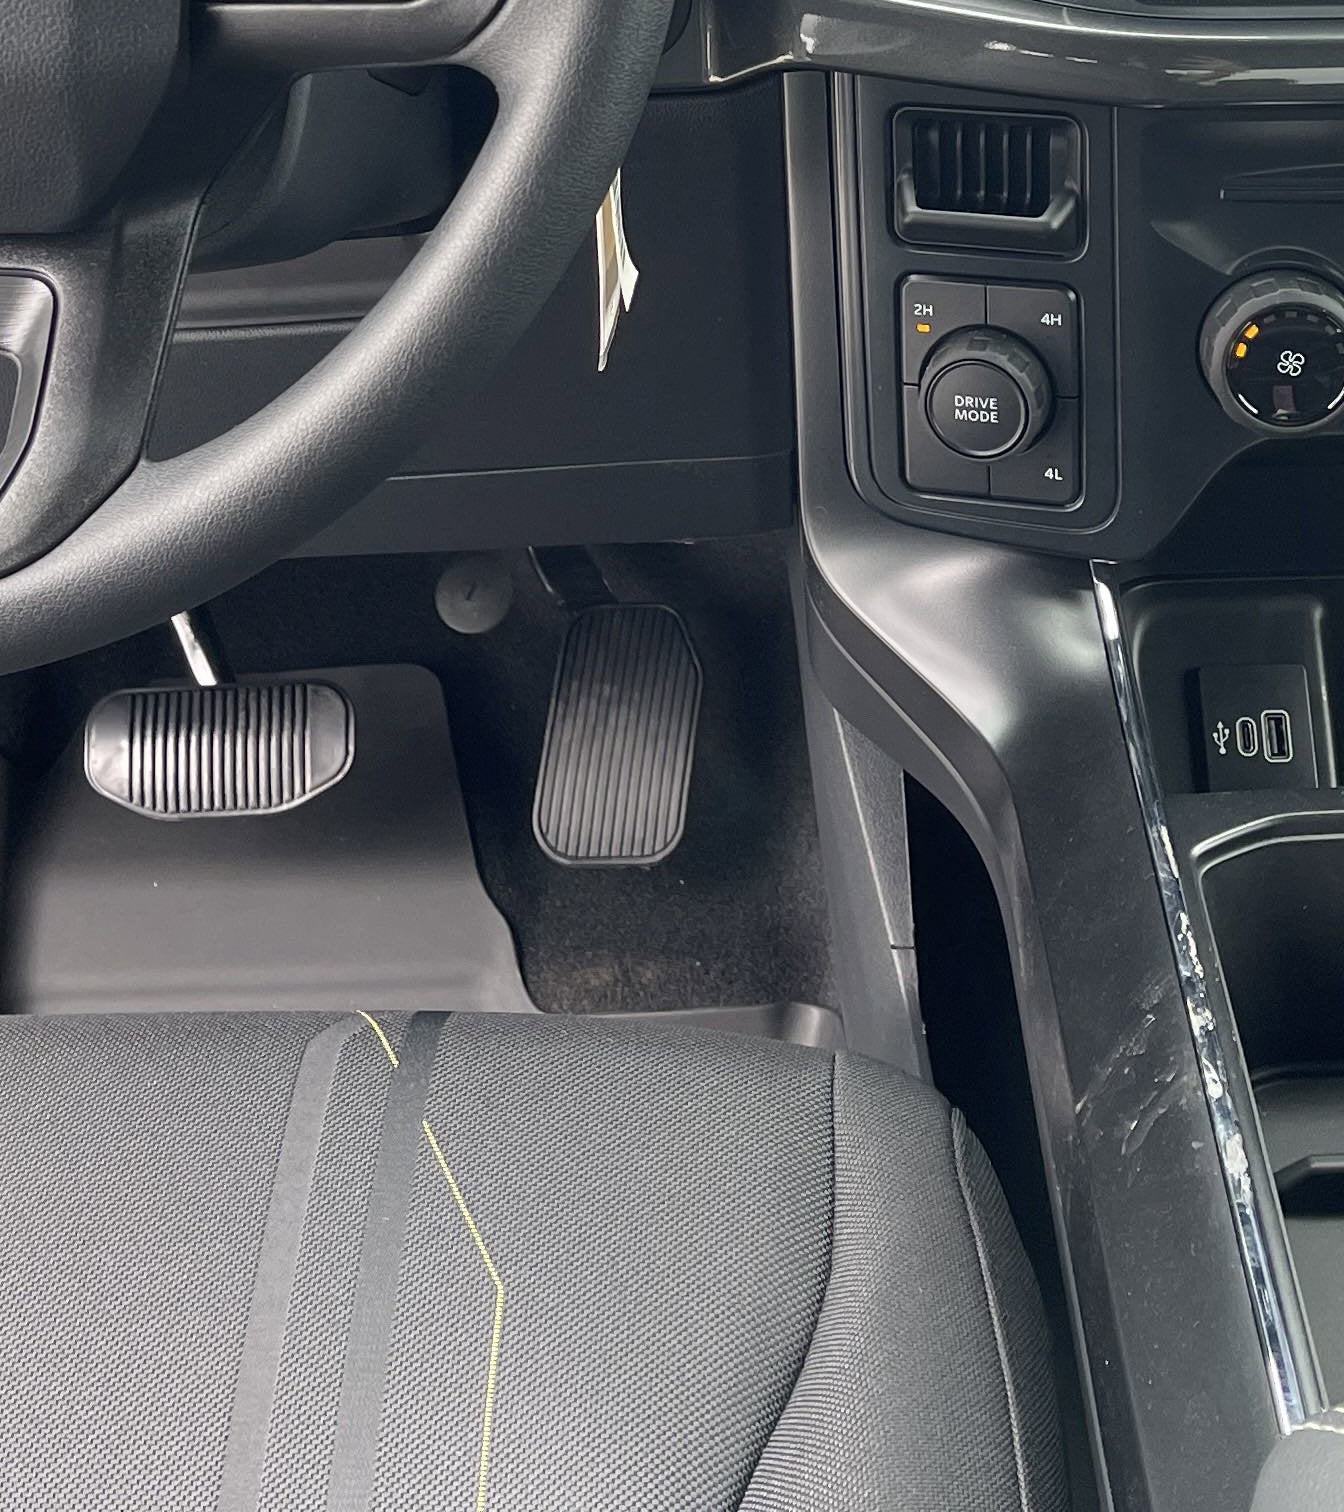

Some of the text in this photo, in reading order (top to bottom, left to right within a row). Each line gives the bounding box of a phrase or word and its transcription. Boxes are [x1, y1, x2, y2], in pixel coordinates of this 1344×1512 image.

[913, 303, 934, 317] 2H
[1040, 312, 1063, 327] 4H
[953, 395, 999, 411] DRIVE
[953, 409, 1001, 425] MODE
[1043, 467, 1064, 482] 4L
